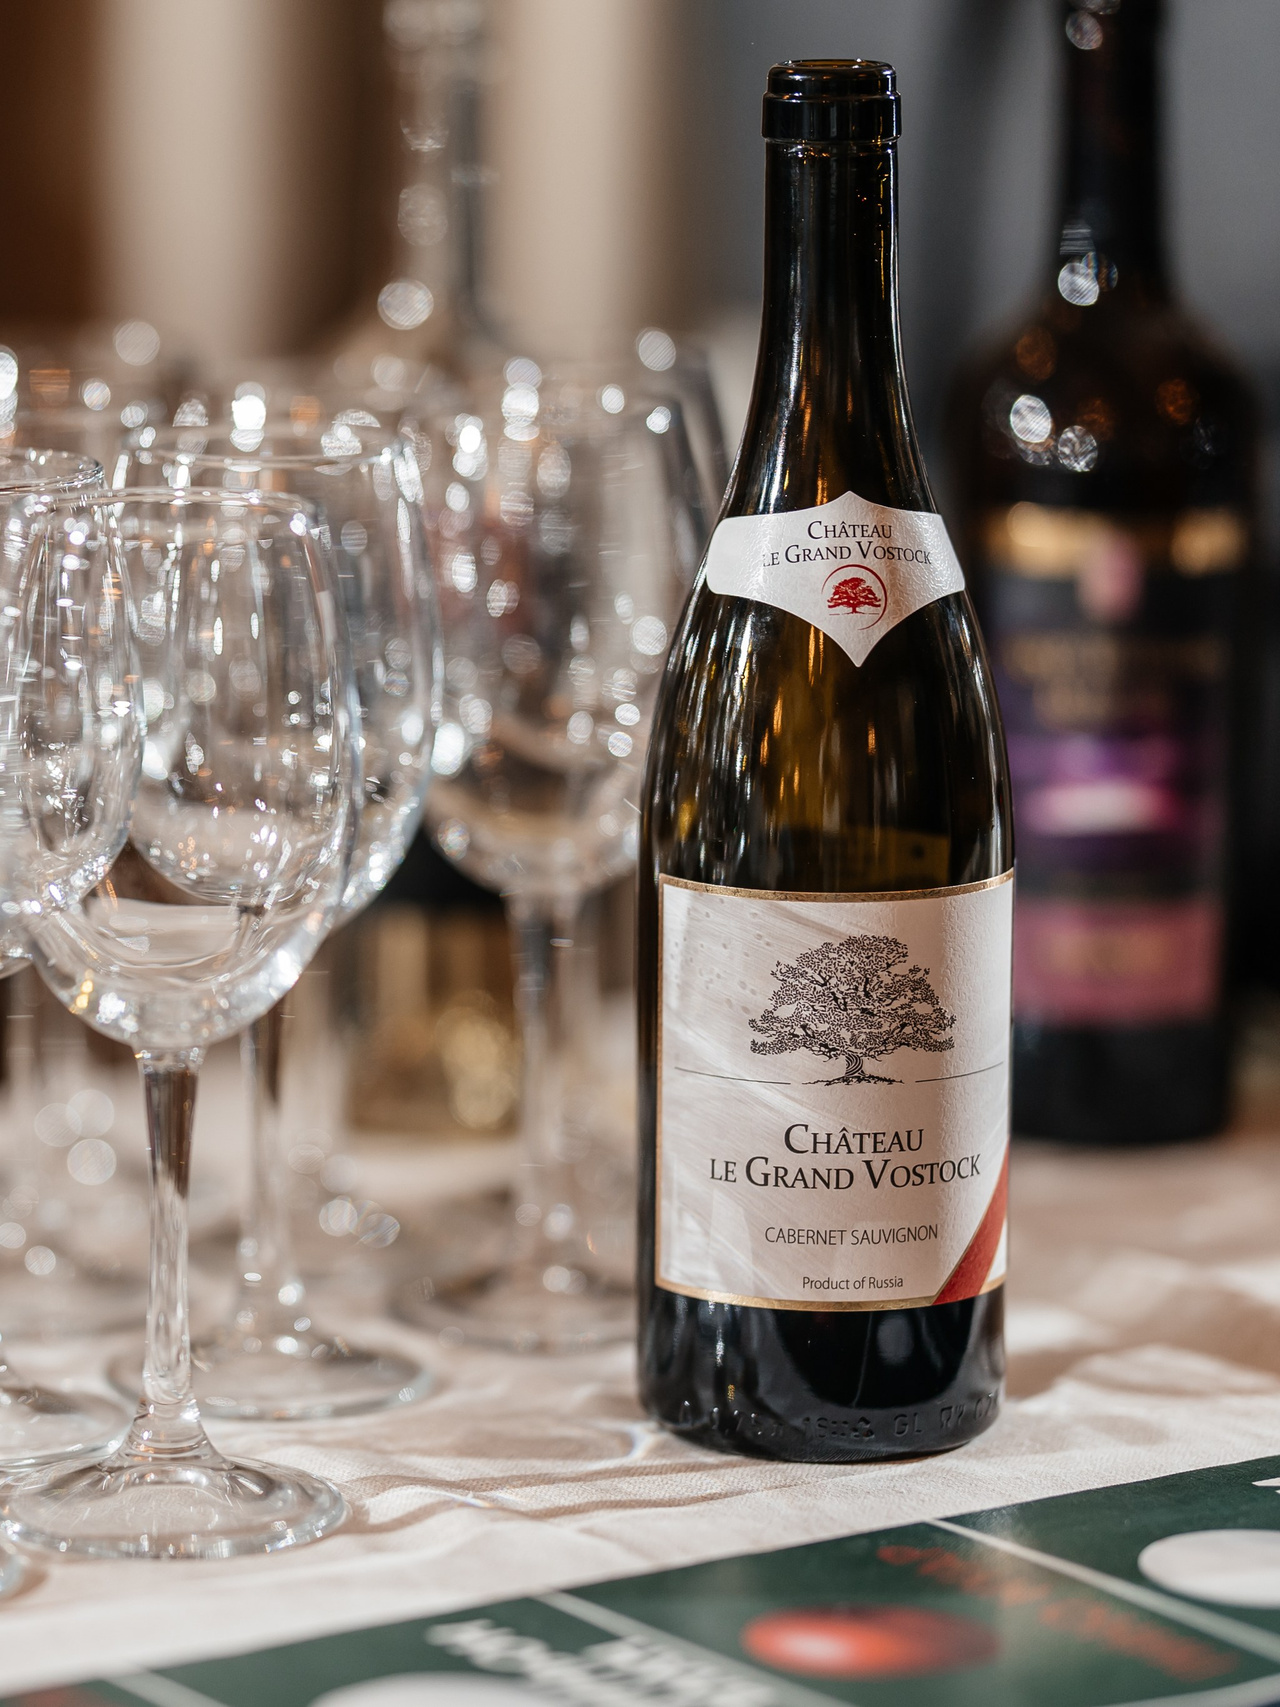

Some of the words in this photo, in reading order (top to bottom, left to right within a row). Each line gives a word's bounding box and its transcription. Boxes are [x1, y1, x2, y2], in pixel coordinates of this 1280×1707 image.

[807, 520, 893, 540] CHÂTEAU
[784, 544, 852, 564] GRAND
[855, 540, 933, 565] VOSTOCK
[783, 1123, 925, 1155] CHÂTEAU
[709, 1157, 738, 1183] LE
[744, 1155, 855, 1190] GRAND
[861, 1153, 982, 1190] VOSTOCK
[764, 1226, 848, 1246] CABERNET
[850, 1223, 939, 1246] SAUVIGNON
[801, 1276, 850, 1290] Product
[853, 1275, 867, 1290] of
[868, 1275, 904, 1290] Russia
